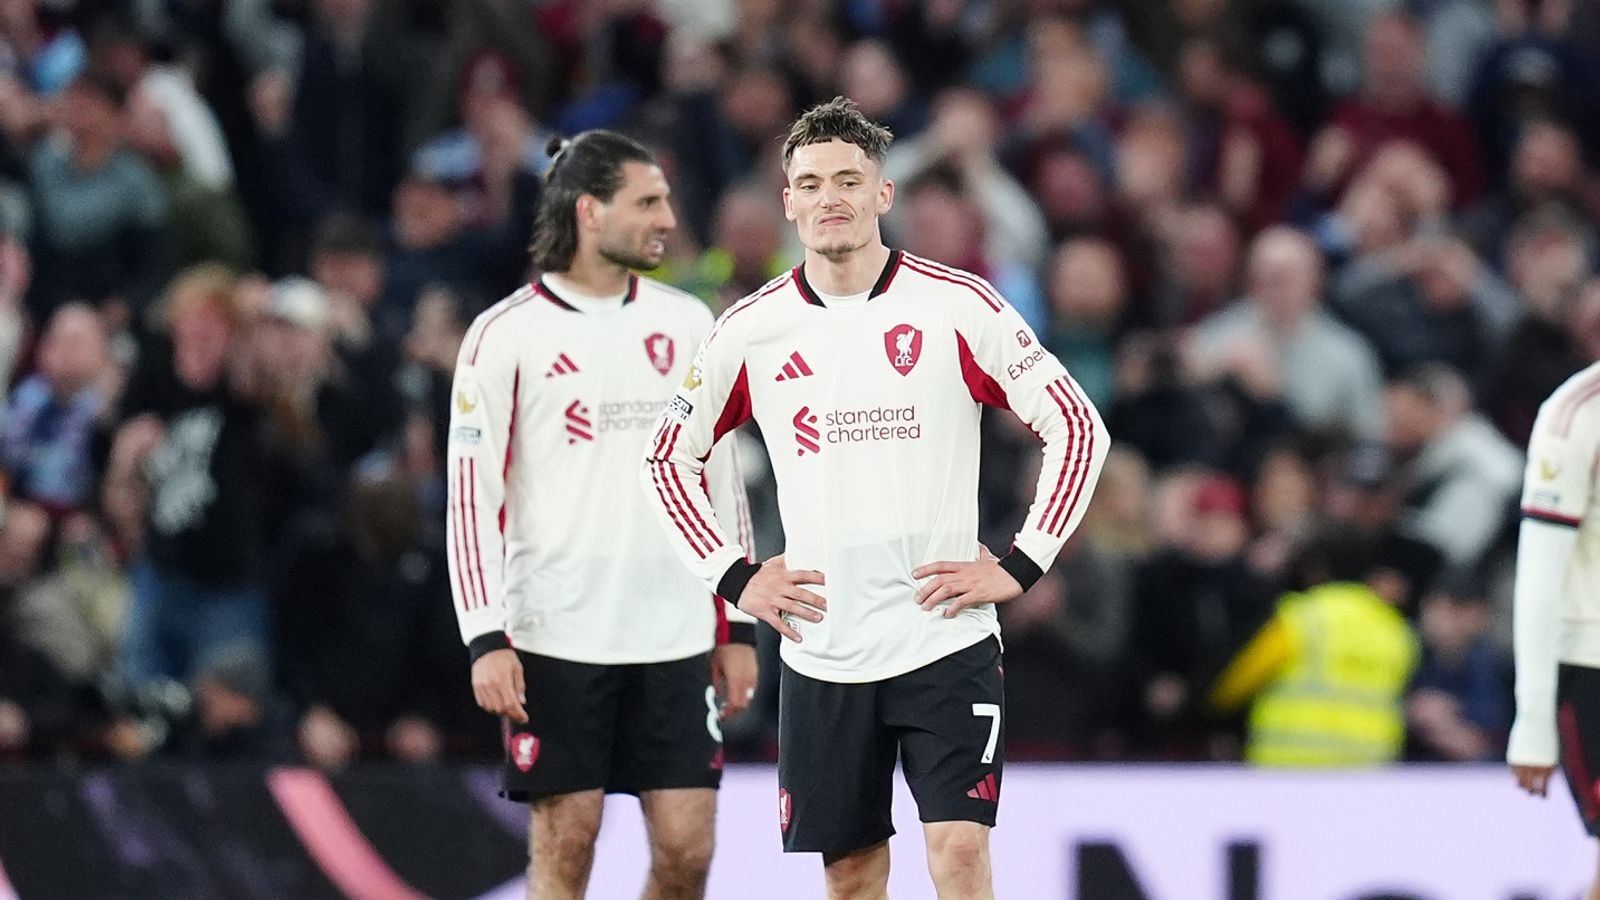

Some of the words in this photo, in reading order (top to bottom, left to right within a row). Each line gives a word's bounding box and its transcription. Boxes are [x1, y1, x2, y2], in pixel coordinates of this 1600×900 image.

[825, 405, 915, 426] standard
[826, 423, 921, 444] chartered
[972, 703, 1001, 763] 7
